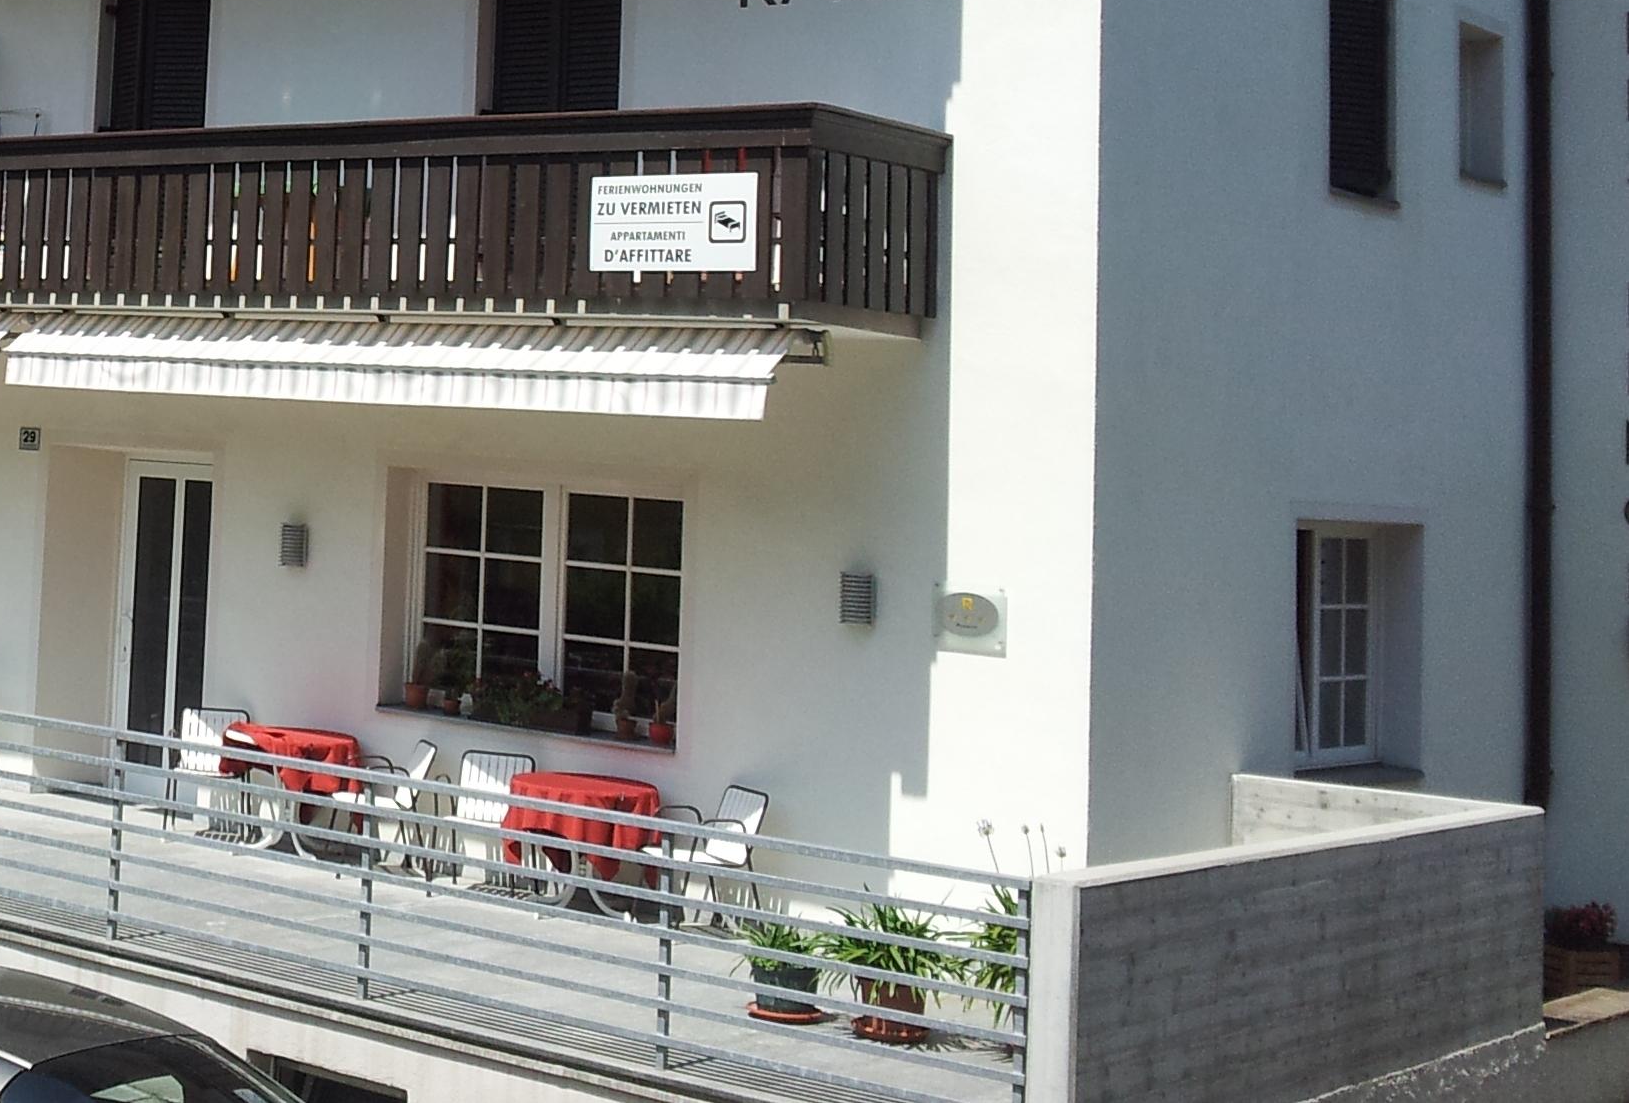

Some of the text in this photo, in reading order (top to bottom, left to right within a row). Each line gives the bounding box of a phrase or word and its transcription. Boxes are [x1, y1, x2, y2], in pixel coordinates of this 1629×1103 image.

[597, 183, 703, 195] FERIENWOHNUNGEN
[597, 201, 702, 216] ZU VERMIETEN
[610, 230, 686, 241] APPARTAMENTI
[604, 249, 692, 263] D'AFFITTARE
[23, 430, 36, 443] 29
